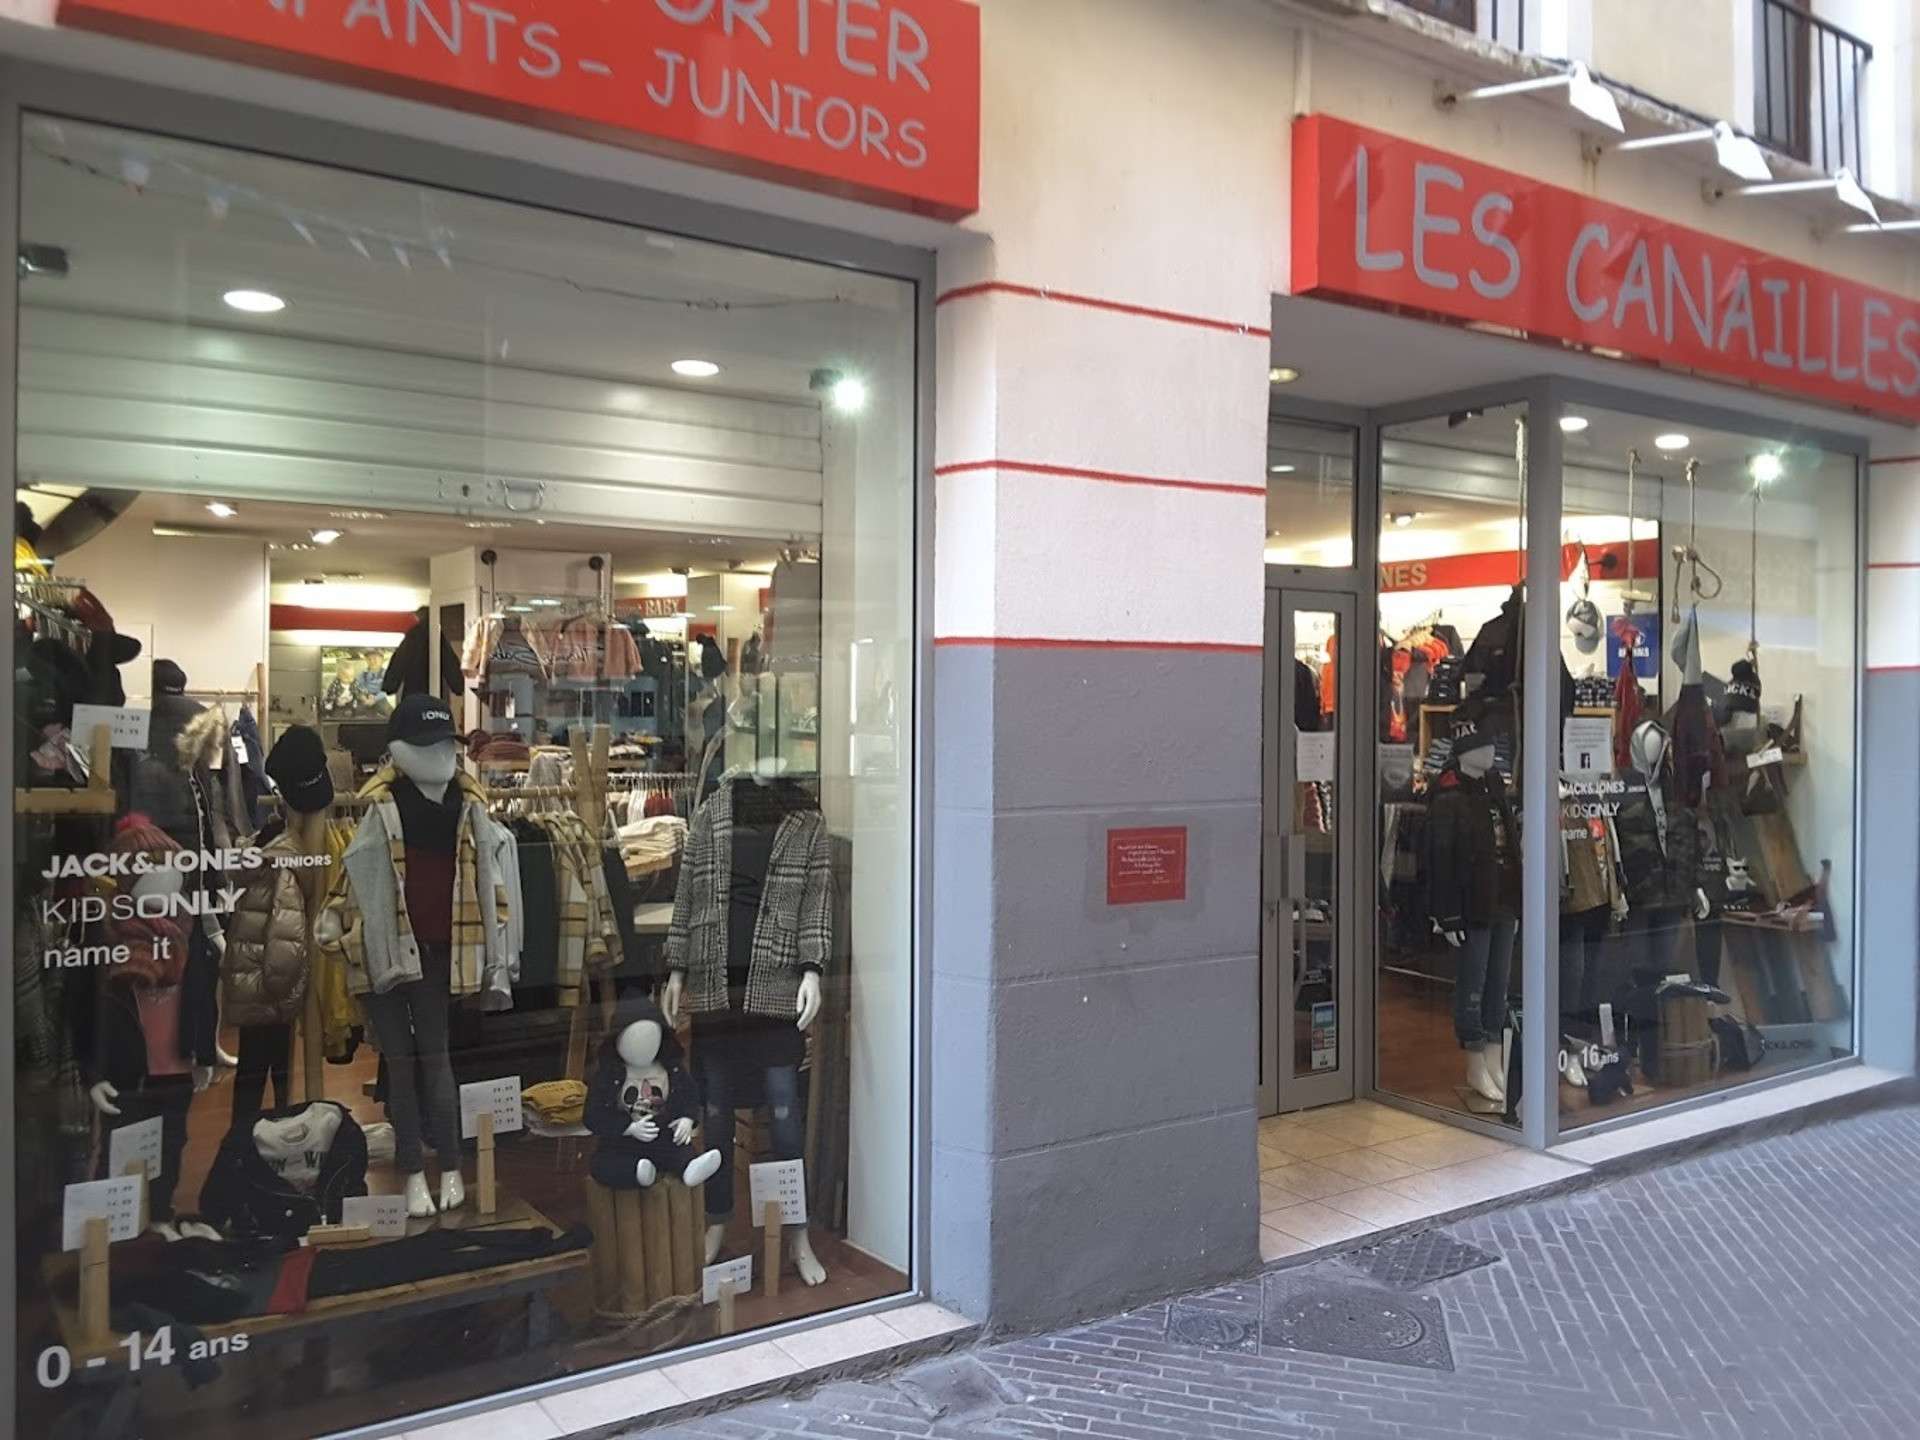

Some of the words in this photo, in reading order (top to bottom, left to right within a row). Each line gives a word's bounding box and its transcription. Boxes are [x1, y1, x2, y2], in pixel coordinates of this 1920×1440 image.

[646, 48, 928, 169] JUNIORS
[1354, 144, 1521, 299] LES
[1565, 222, 1920, 398] CANAILLES
[41, 847, 263, 879] JACK&JONES
[270, 854, 333, 869] JUNIORS
[42, 887, 246, 925] KIDSONLY
[44, 944, 131, 969] name
[152, 936, 171, 961] it
[1581, 1043, 1600, 1069] 16
[36, 1345, 72, 1389] 0
[119, 1325, 176, 1371] 14
[189, 1332, 249, 1360] ans
